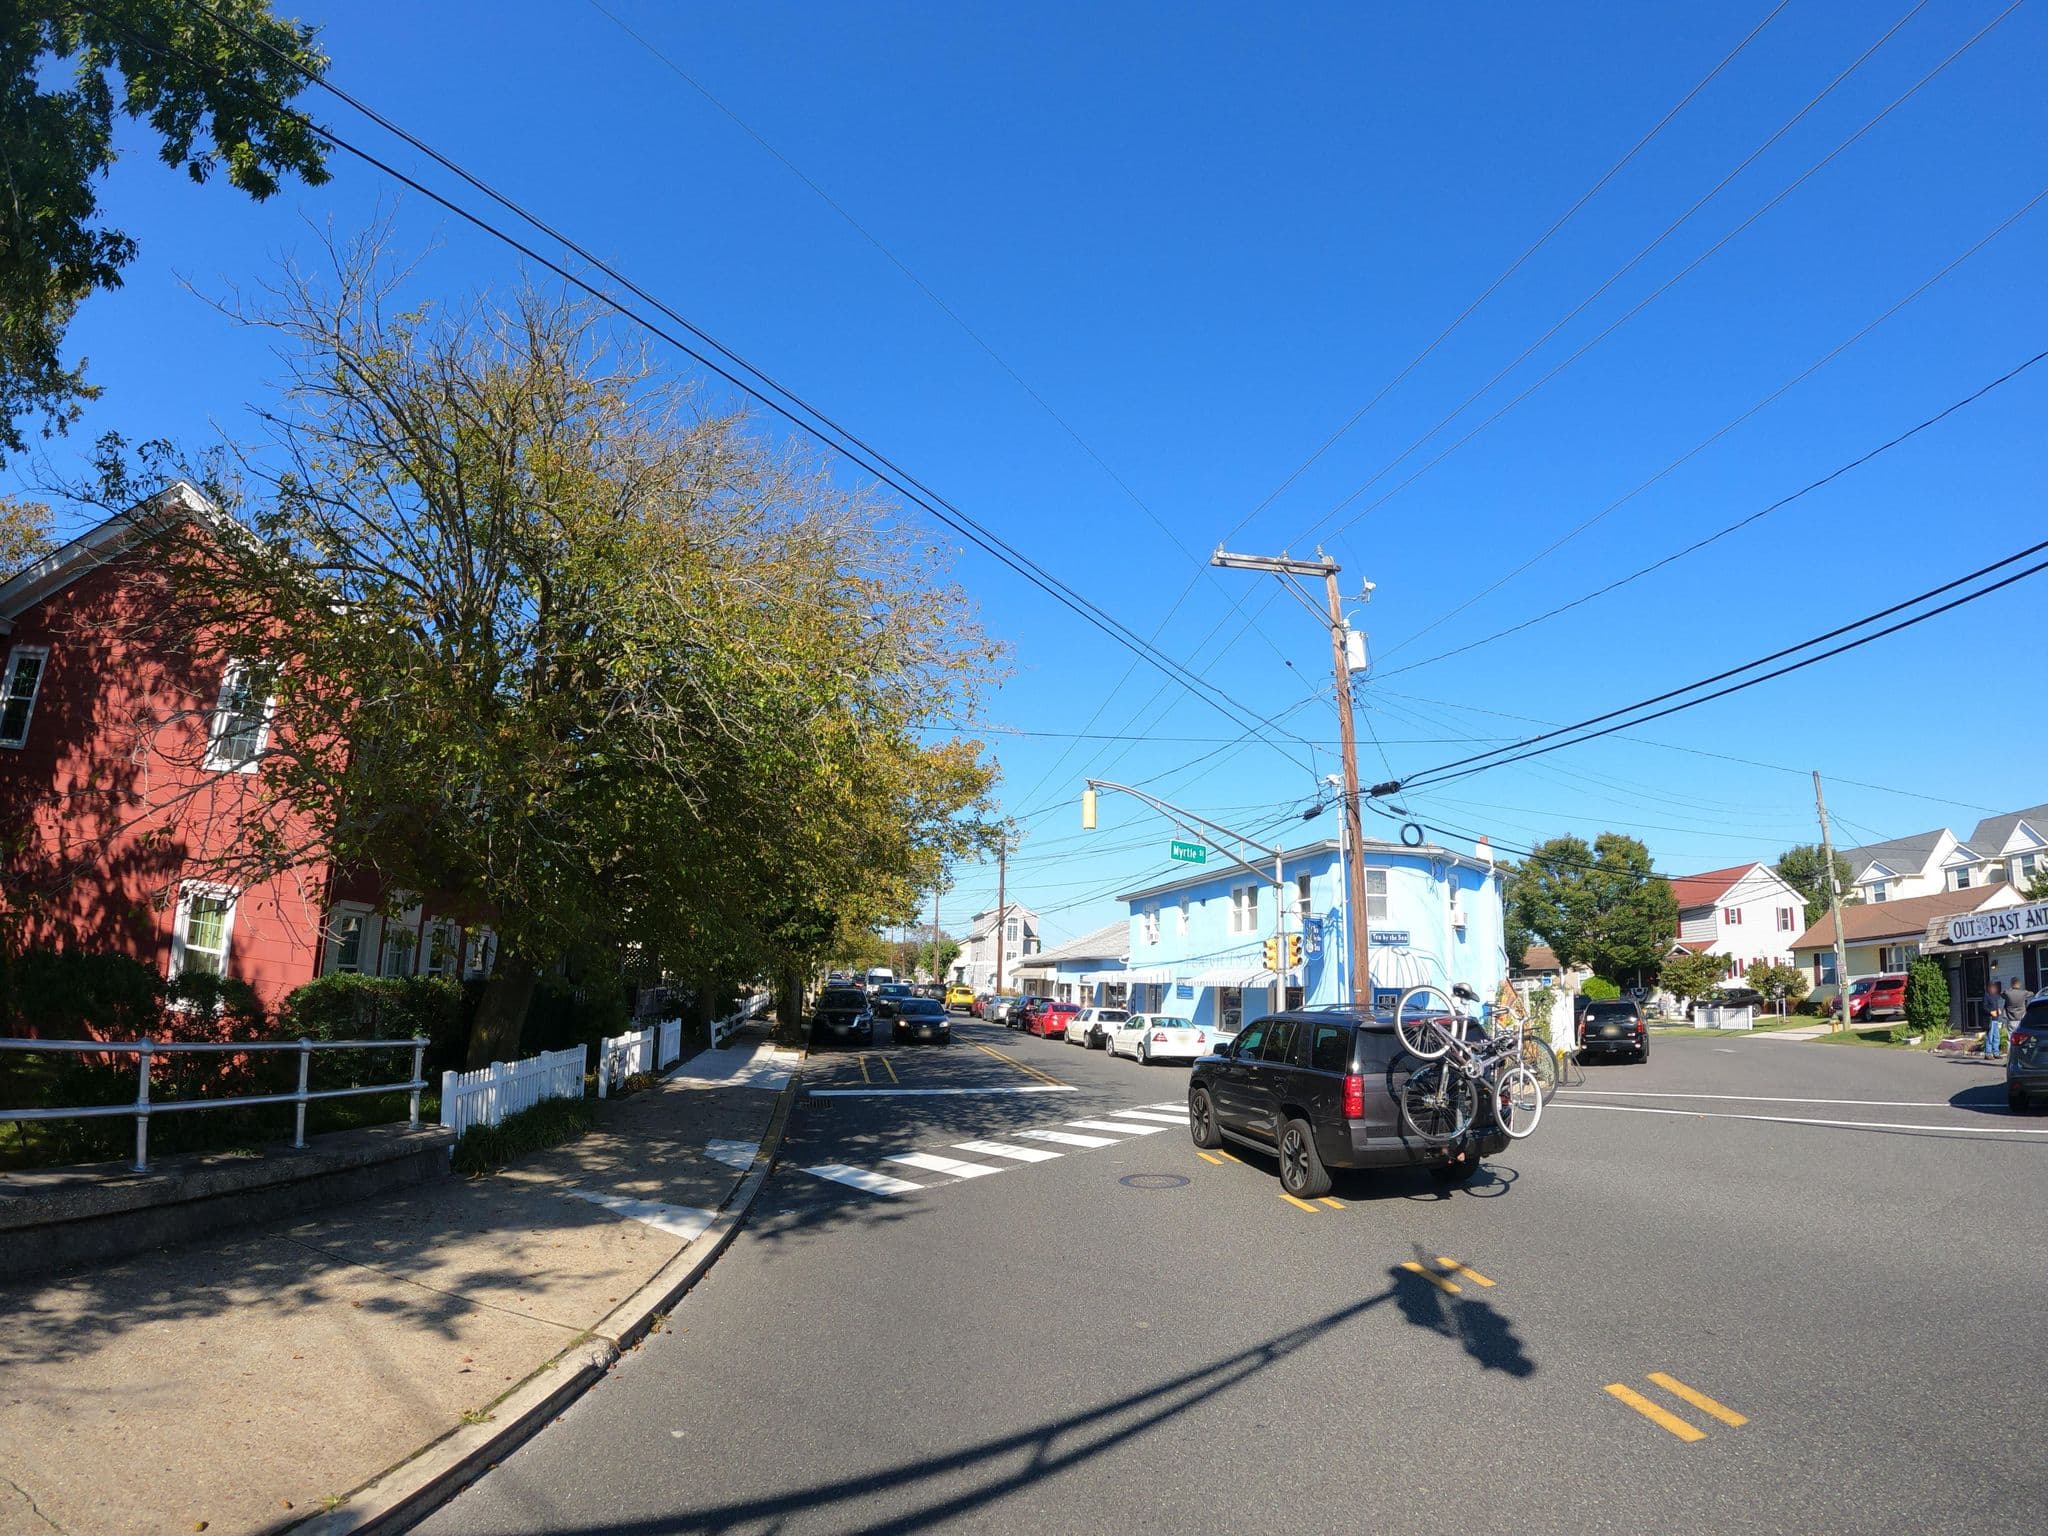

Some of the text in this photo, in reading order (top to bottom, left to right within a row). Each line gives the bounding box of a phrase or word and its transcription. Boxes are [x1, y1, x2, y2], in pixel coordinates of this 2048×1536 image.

[1173, 845, 1197, 859] Myrtle
[1953, 921, 1975, 939] OUT
[1989, 912, 2021, 934] PAST
